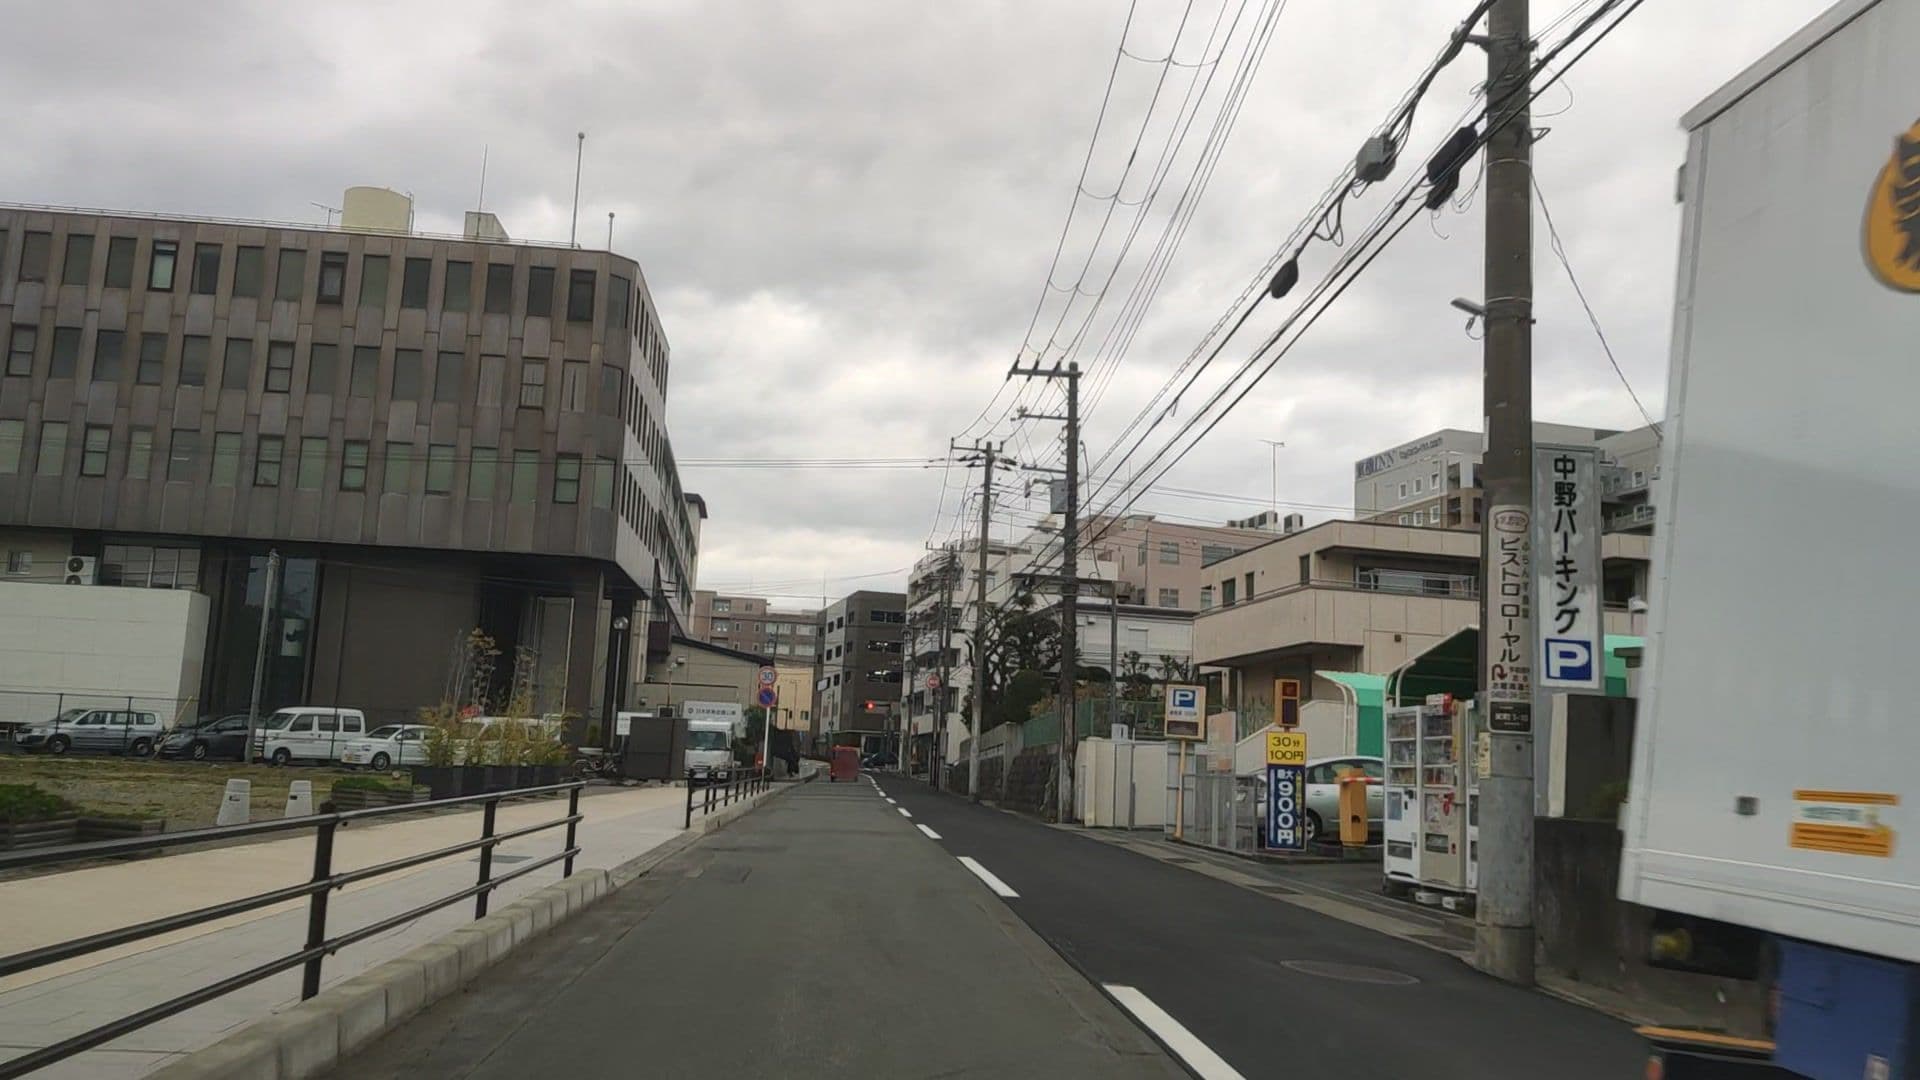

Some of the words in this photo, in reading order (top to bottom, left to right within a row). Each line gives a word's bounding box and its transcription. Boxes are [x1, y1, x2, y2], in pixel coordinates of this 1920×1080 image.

[1553, 454, 1579, 634] 中野パーキング
[762, 671, 774, 681] 30
[1270, 750, 1304, 760] 100円
[1278, 781, 1294, 844] 900円
